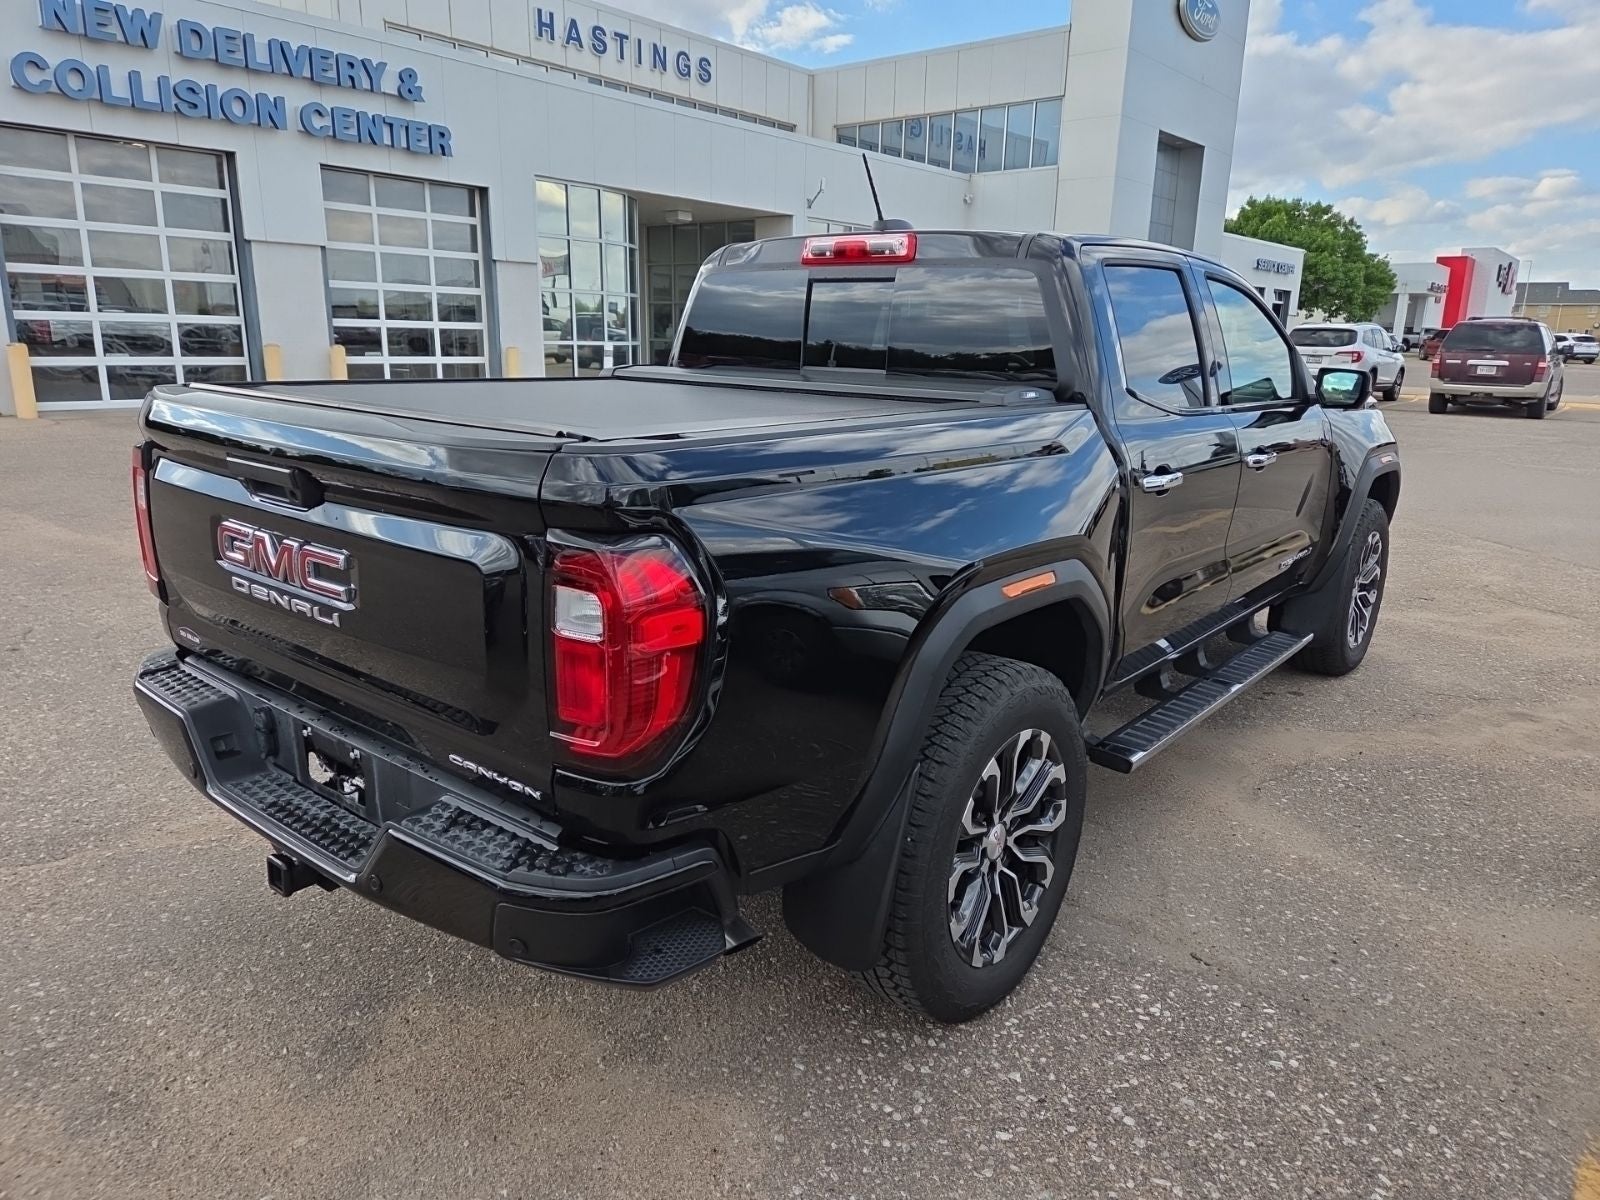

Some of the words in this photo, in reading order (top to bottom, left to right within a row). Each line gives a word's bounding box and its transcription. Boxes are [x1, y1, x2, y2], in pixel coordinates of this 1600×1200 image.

[40, 0, 163, 49] NEW
[176, 19, 388, 93] DELIVERY
[398, 67, 426, 102] &
[535, 8, 712, 84] HASTINGS
[10, 52, 288, 130] COLLISION
[299, 101, 453, 157] CENTER
[217, 520, 356, 602] GMC
[231, 576, 341, 628] DENALI
[448, 754, 542, 801] CANYON
